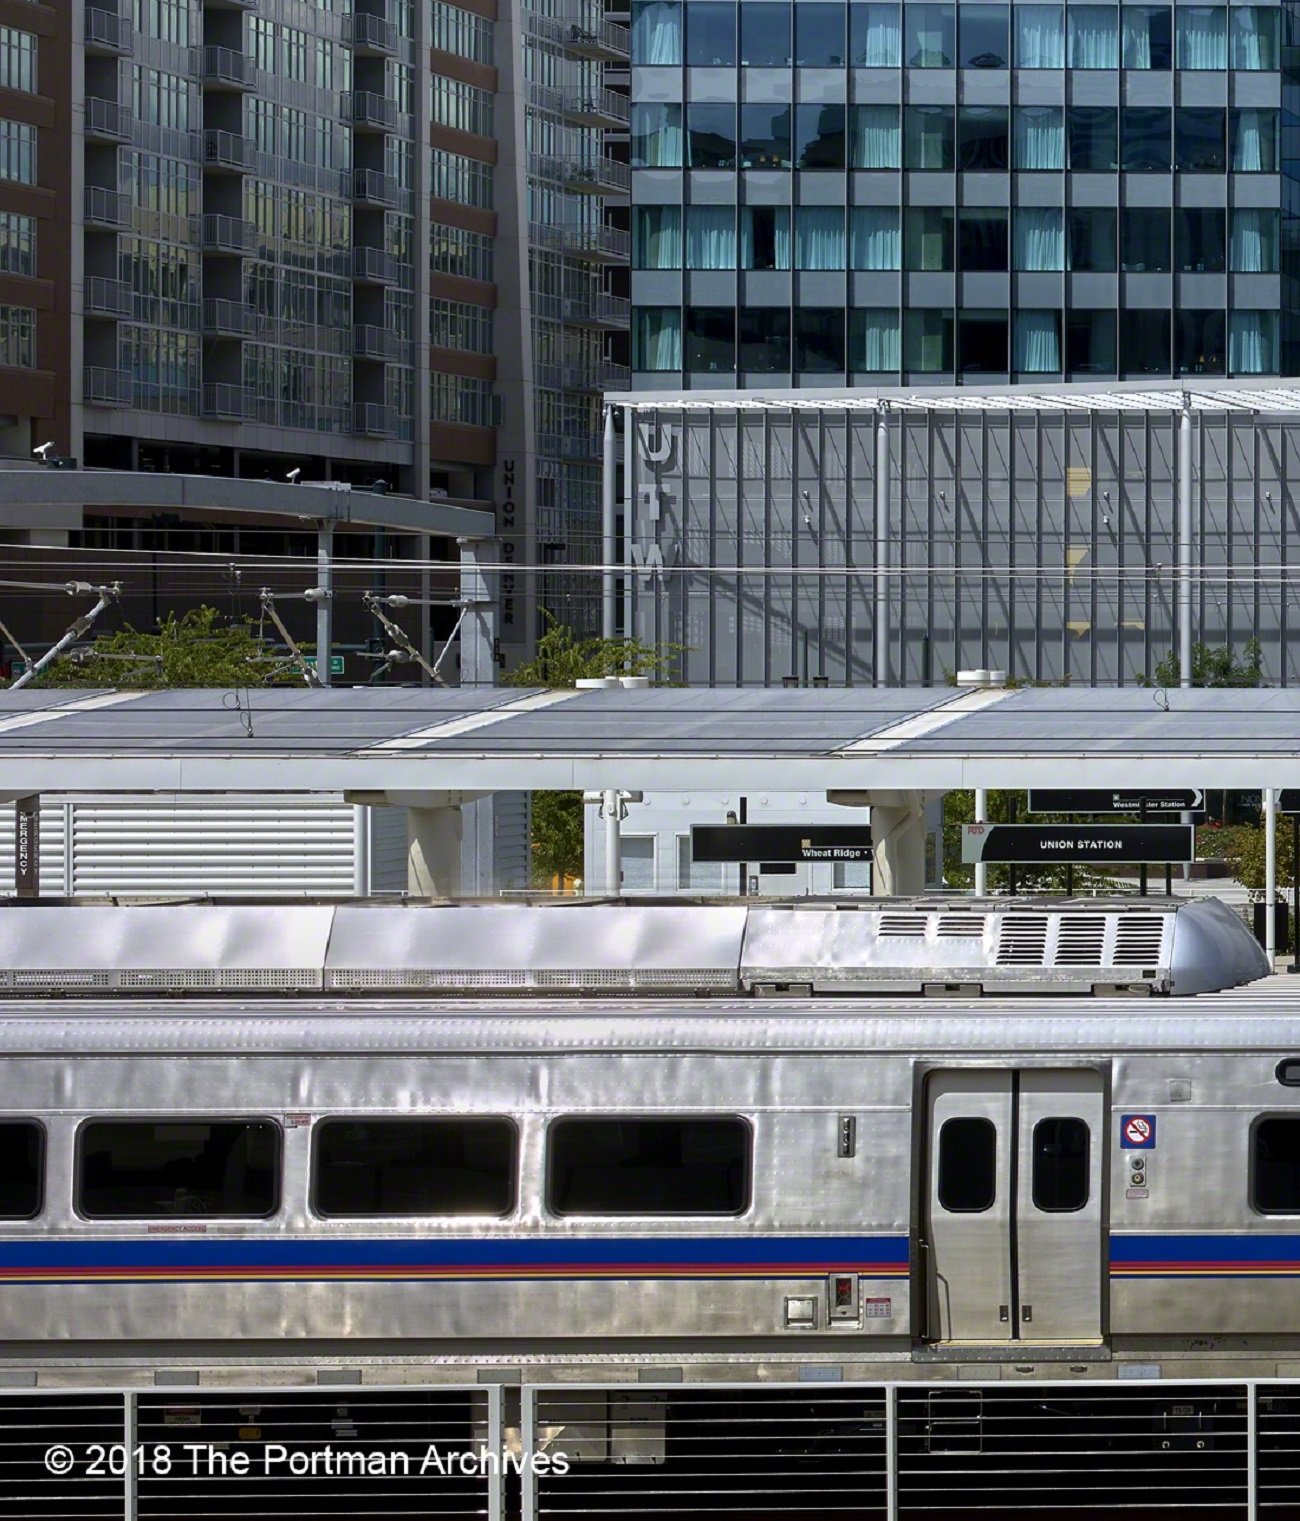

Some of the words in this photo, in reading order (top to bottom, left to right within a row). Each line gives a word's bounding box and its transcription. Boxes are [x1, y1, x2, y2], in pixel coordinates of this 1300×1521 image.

[503, 459, 515, 527] UNION
[1040, 840, 1074, 849] UNION
[1077, 840, 1123, 849] STATION
[801, 849, 832, 857] Wheat
[833, 849, 861, 859] Ridge
